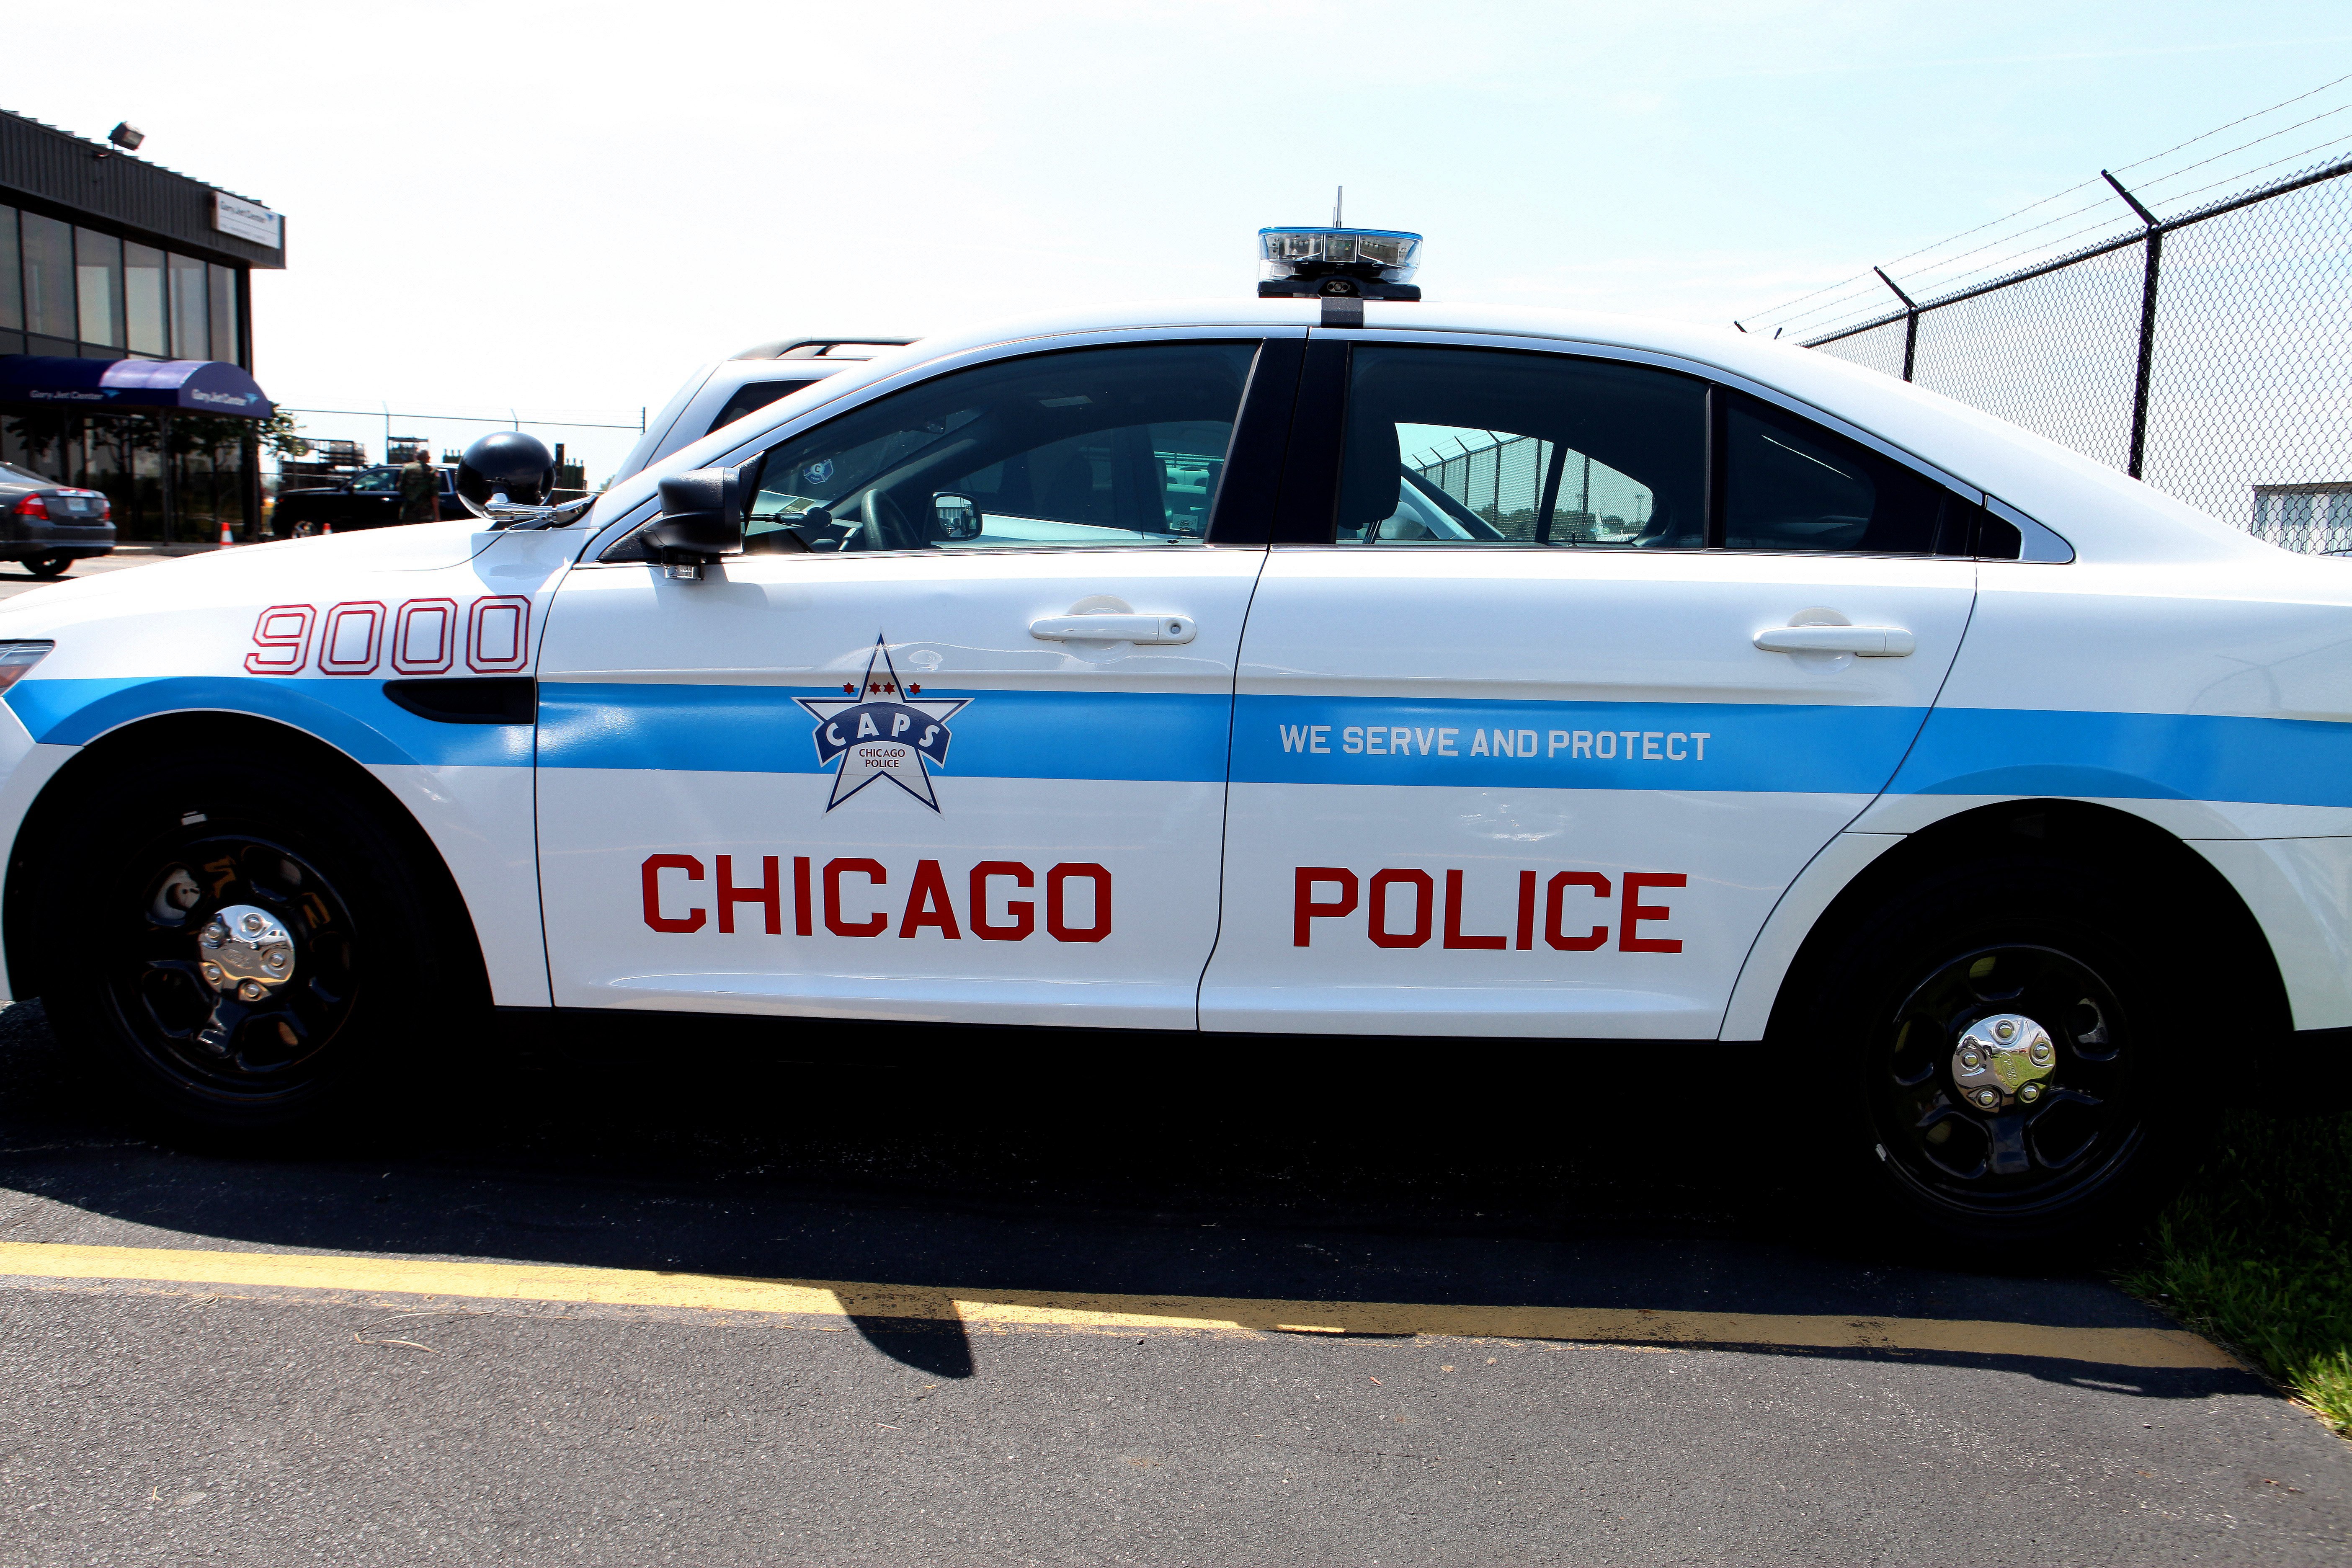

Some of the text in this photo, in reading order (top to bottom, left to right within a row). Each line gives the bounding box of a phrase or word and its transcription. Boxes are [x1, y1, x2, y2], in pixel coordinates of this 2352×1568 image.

[29, 390, 53, 400] Gary
[71, 391, 103, 400] Center
[191, 388, 210, 403] Gary
[222, 393, 247, 407] Center
[245, 595, 531, 675] 9000
[826, 713, 940, 747] CAPS
[1279, 725, 1711, 761] WE SERVE AND PROTECT
[859, 748, 905, 758] CHICAGO
[865, 759, 900, 768] POLICE
[642, 854, 1112, 943] CHICAGO
[1294, 867, 1687, 953] POLICE
